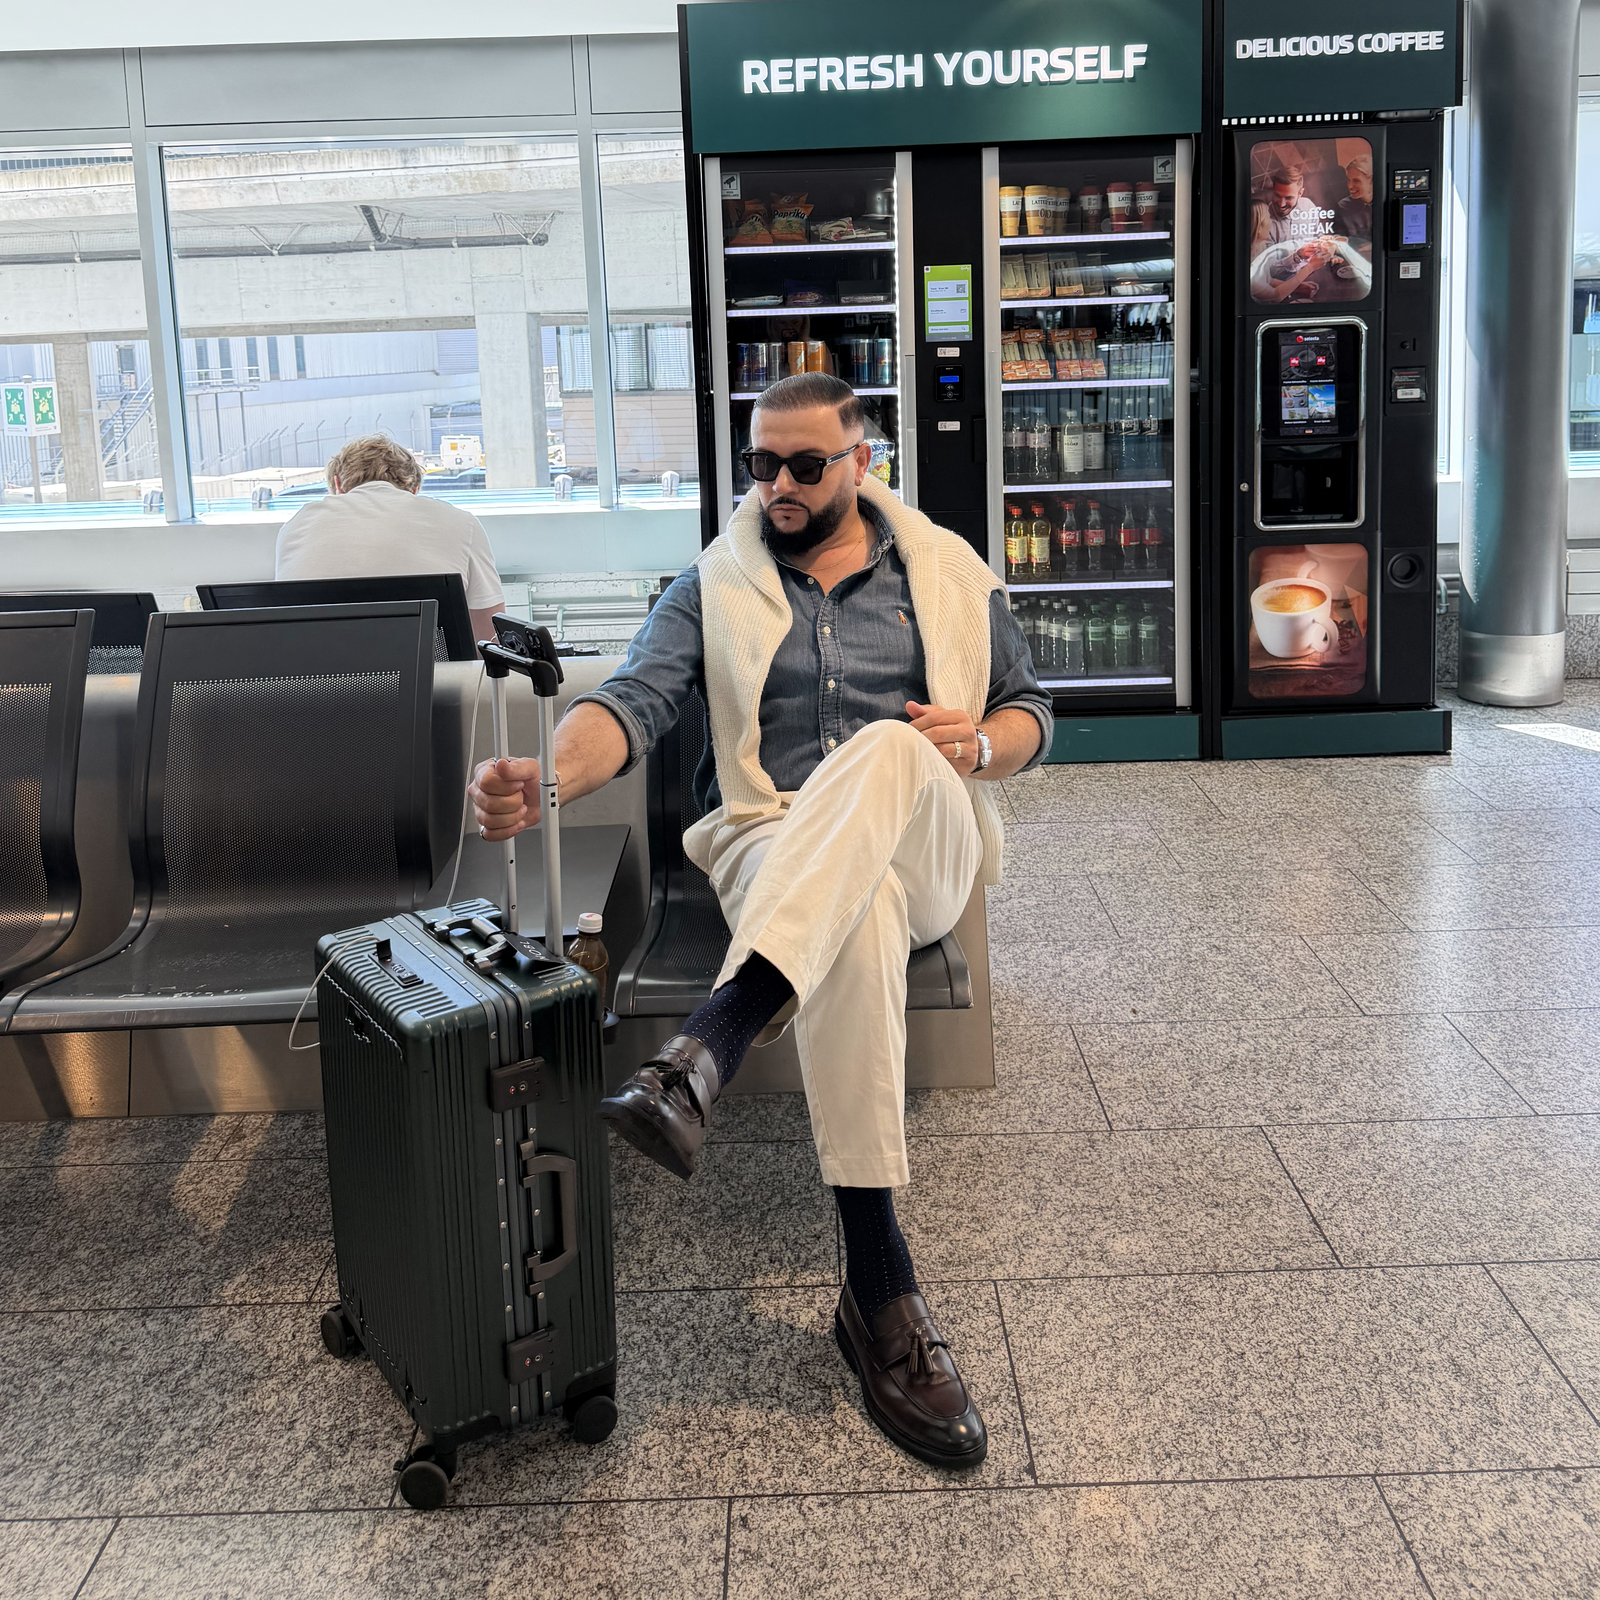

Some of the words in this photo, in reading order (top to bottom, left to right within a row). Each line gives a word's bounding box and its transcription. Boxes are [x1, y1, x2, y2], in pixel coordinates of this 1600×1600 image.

[1235, 33, 1355, 60] DELICIOUS
[1357, 30, 1445, 54] COFFEE
[742, 52, 924, 95] REFRESH
[934, 43, 1149, 88] YOURSELF
[773, 208, 806, 220] Paprika
[1289, 206, 1336, 221] Coffee
[1289, 221, 1335, 236] BREAK
[519, 940, 551, 961] NOBL
